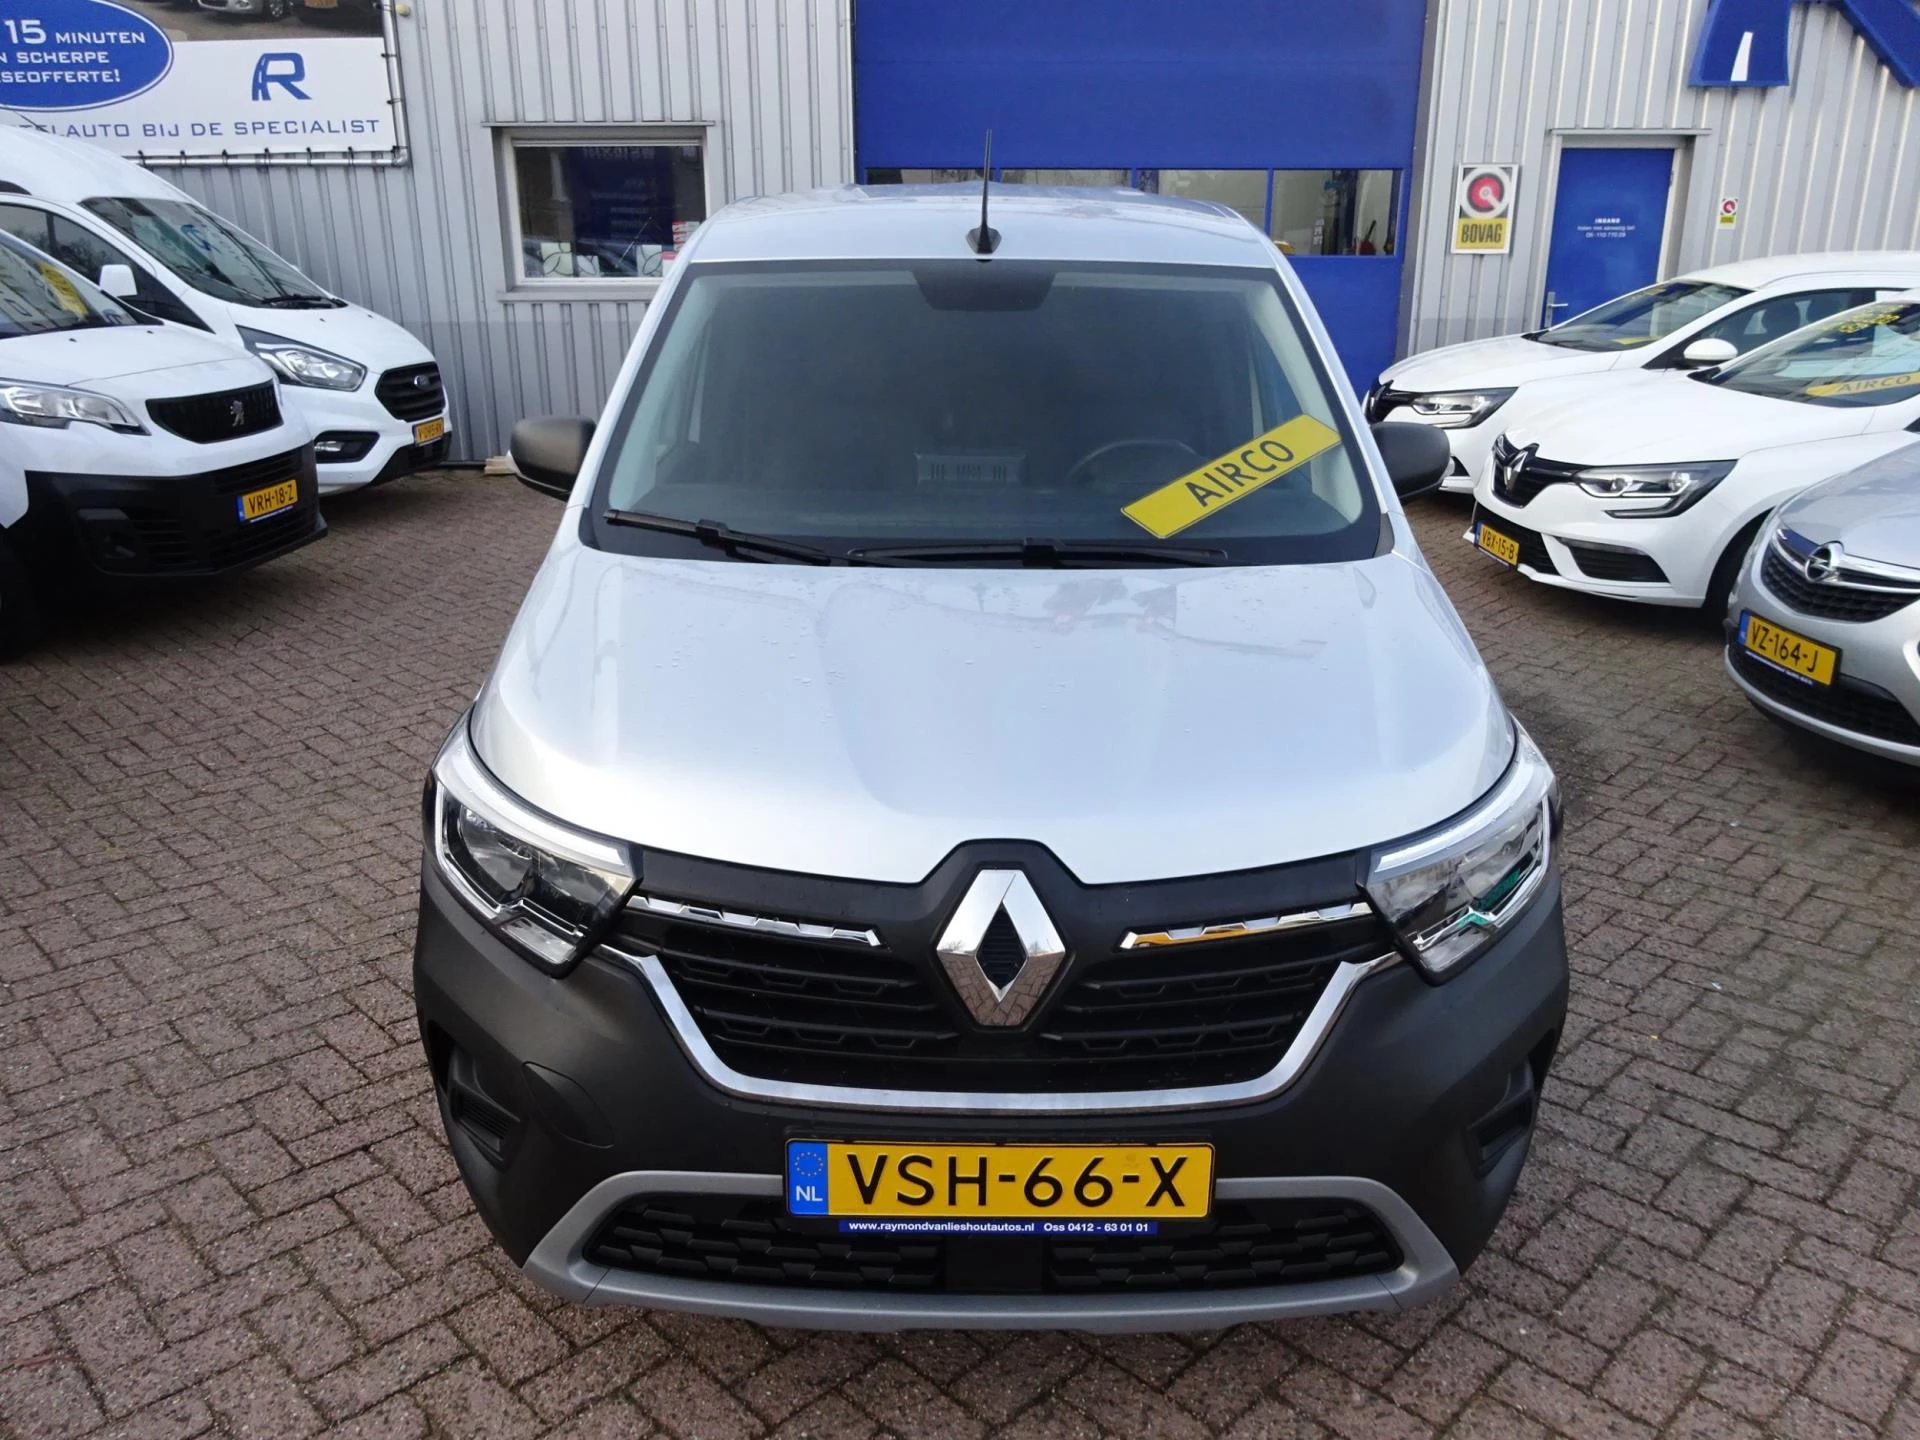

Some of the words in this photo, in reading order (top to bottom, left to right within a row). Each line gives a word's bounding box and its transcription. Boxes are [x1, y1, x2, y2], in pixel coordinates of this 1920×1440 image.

[4, 19, 47, 45] 15
[55, 31, 146, 44] MINUTEN
[16, 51, 110, 63] SCHERPE
[142, 123, 180, 137] BIJ
[191, 122, 223, 136] DE
[234, 119, 380, 136] SPECIALIST
[1461, 223, 1502, 243] BOVAG
[1838, 375, 1911, 393] AIRCO
[1184, 440, 1294, 508] AIRCO
[248, 483, 294, 514] VRH-18-Z
[1752, 620, 1819, 673] VZ-164-J
[795, 1185, 823, 1203] NL
[846, 1153, 1187, 1208] VSH-66-X
[848, 1221, 1035, 1233] www.raymondvanlieshoutautos.nl
[1043, 1222, 1065, 1232] Oss
[1067, 1222, 1094, 1232] 0412
[1104, 1222, 1118, 1232] 63
[1120, 1222, 1133, 1232] 01
[1136, 1222, 1149, 1232] 01
